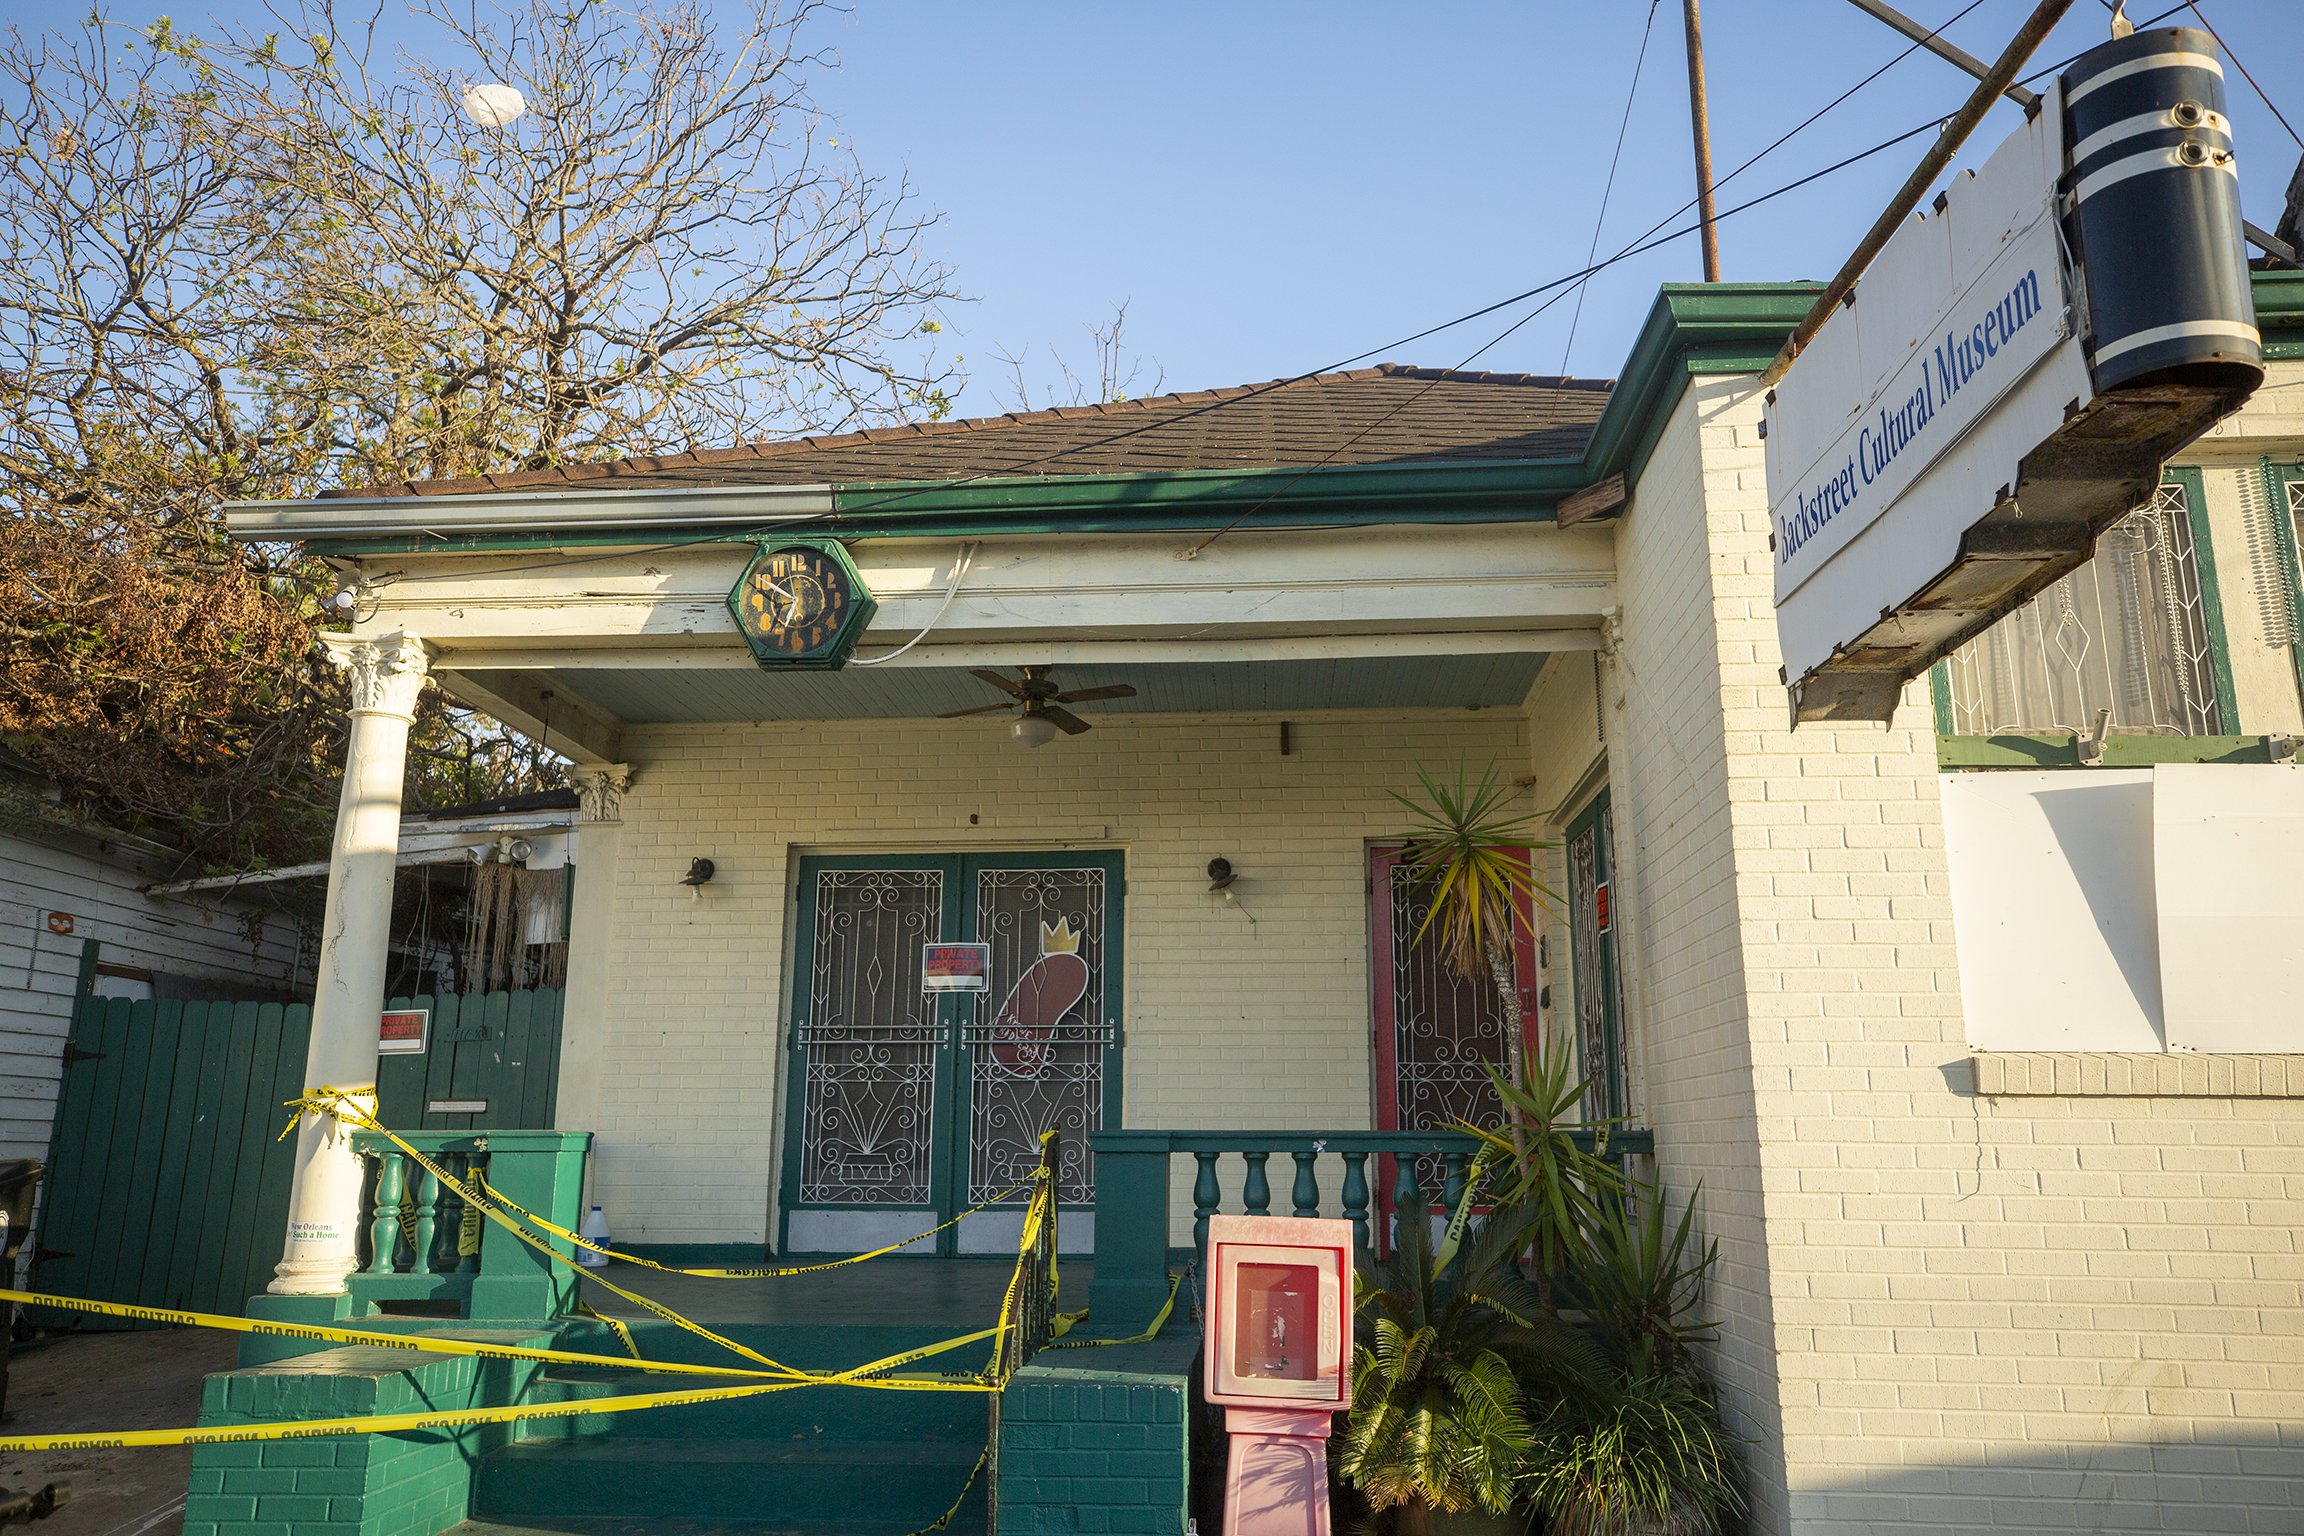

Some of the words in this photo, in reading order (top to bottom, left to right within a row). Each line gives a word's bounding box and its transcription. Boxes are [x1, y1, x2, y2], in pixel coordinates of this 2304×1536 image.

[1781, 455, 1858, 566] Backstreet
[1859, 357, 1935, 486] Cultural
[1935, 269, 2042, 408] Museum
[752, 594, 764, 612] 9
[774, 628, 784, 646] 7
[934, 948, 977, 959] PRIVATE
[928, 959, 983, 969] PROPERTY
[380, 1025, 422, 1034] ROPERTY
[303, 1222, 333, 1231] Orleans
[292, 1230, 308, 1239] Such
[1322, 1294, 1335, 1354] OPEN
